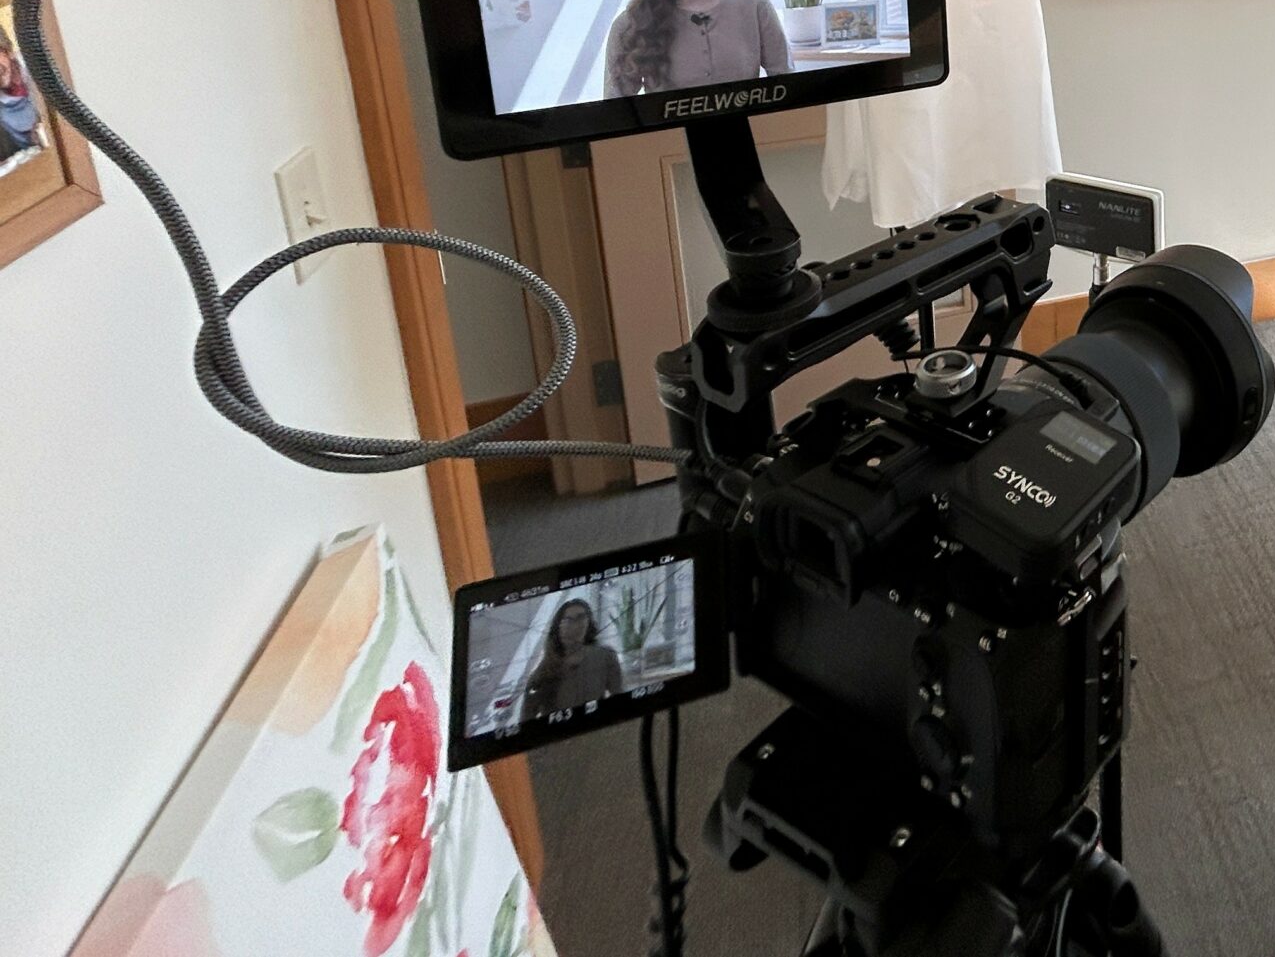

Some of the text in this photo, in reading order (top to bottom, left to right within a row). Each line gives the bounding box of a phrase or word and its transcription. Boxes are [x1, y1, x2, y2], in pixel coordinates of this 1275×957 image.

[663, 84, 787, 119] FEELWORLD
[1098, 201, 1142, 217] NANLITE
[992, 465, 1051, 504] SYNCO
[1004, 490, 1022, 505] G2
